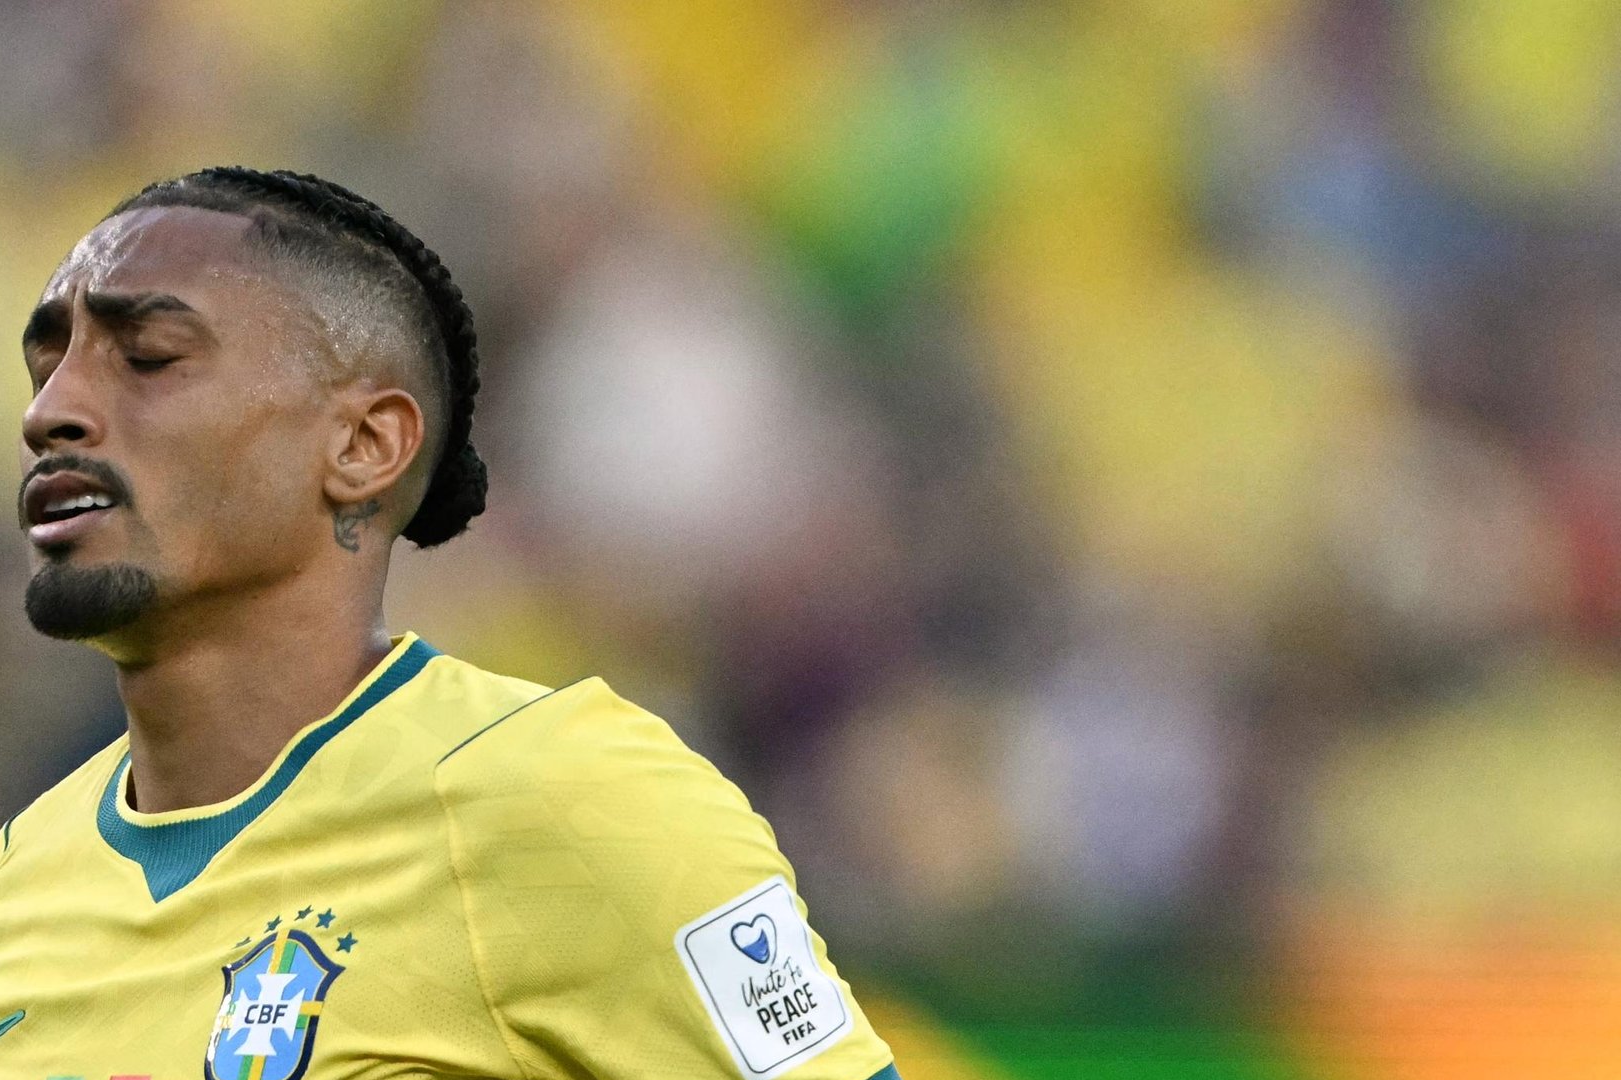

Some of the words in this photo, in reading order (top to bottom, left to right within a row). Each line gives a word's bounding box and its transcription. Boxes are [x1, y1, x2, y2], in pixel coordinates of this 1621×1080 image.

[741, 968, 786, 1007] Unite
[244, 1004, 288, 1024] CBF
[756, 982, 817, 1033] PEACE
[782, 1020, 817, 1045] FIFA
